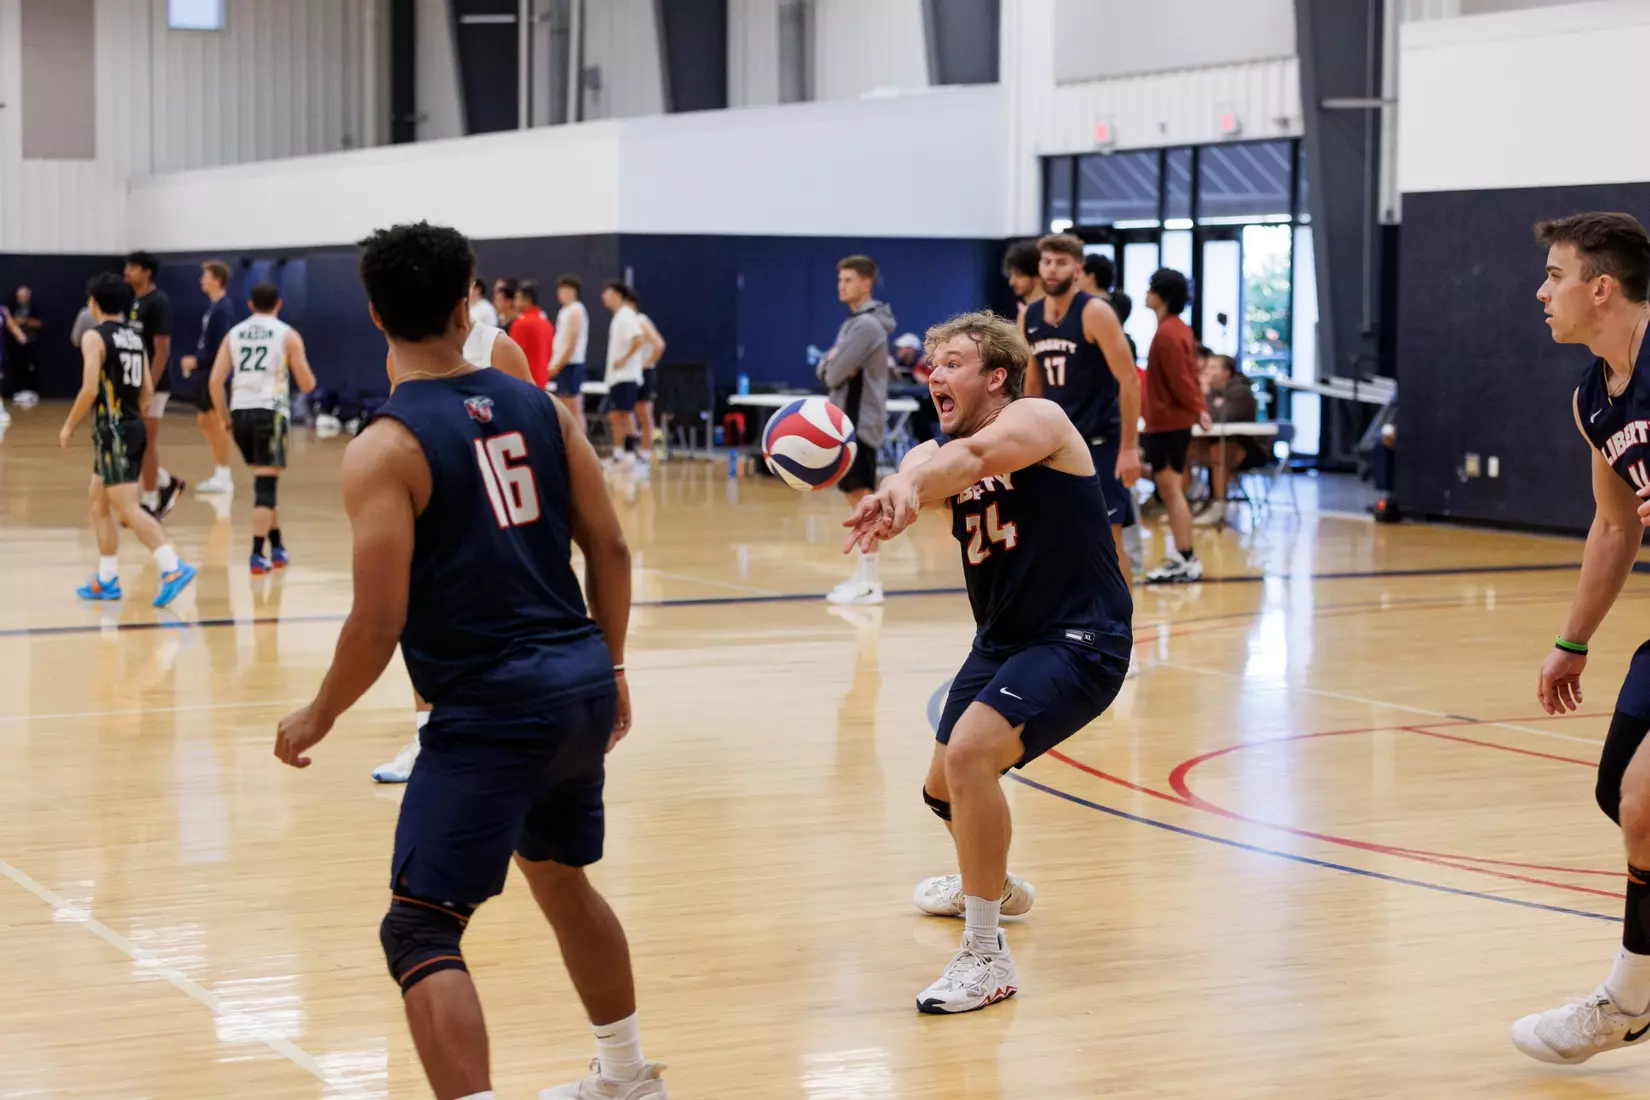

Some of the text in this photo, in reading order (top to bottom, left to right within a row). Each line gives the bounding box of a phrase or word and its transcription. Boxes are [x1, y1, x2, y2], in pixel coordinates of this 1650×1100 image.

[119, 352, 143, 387] 20
[240, 345, 268, 372] 22
[1043, 355, 1068, 386] 17
[1601, 420, 1650, 466] LIBERT
[473, 430, 541, 530] 16
[966, 500, 1018, 566] 24
